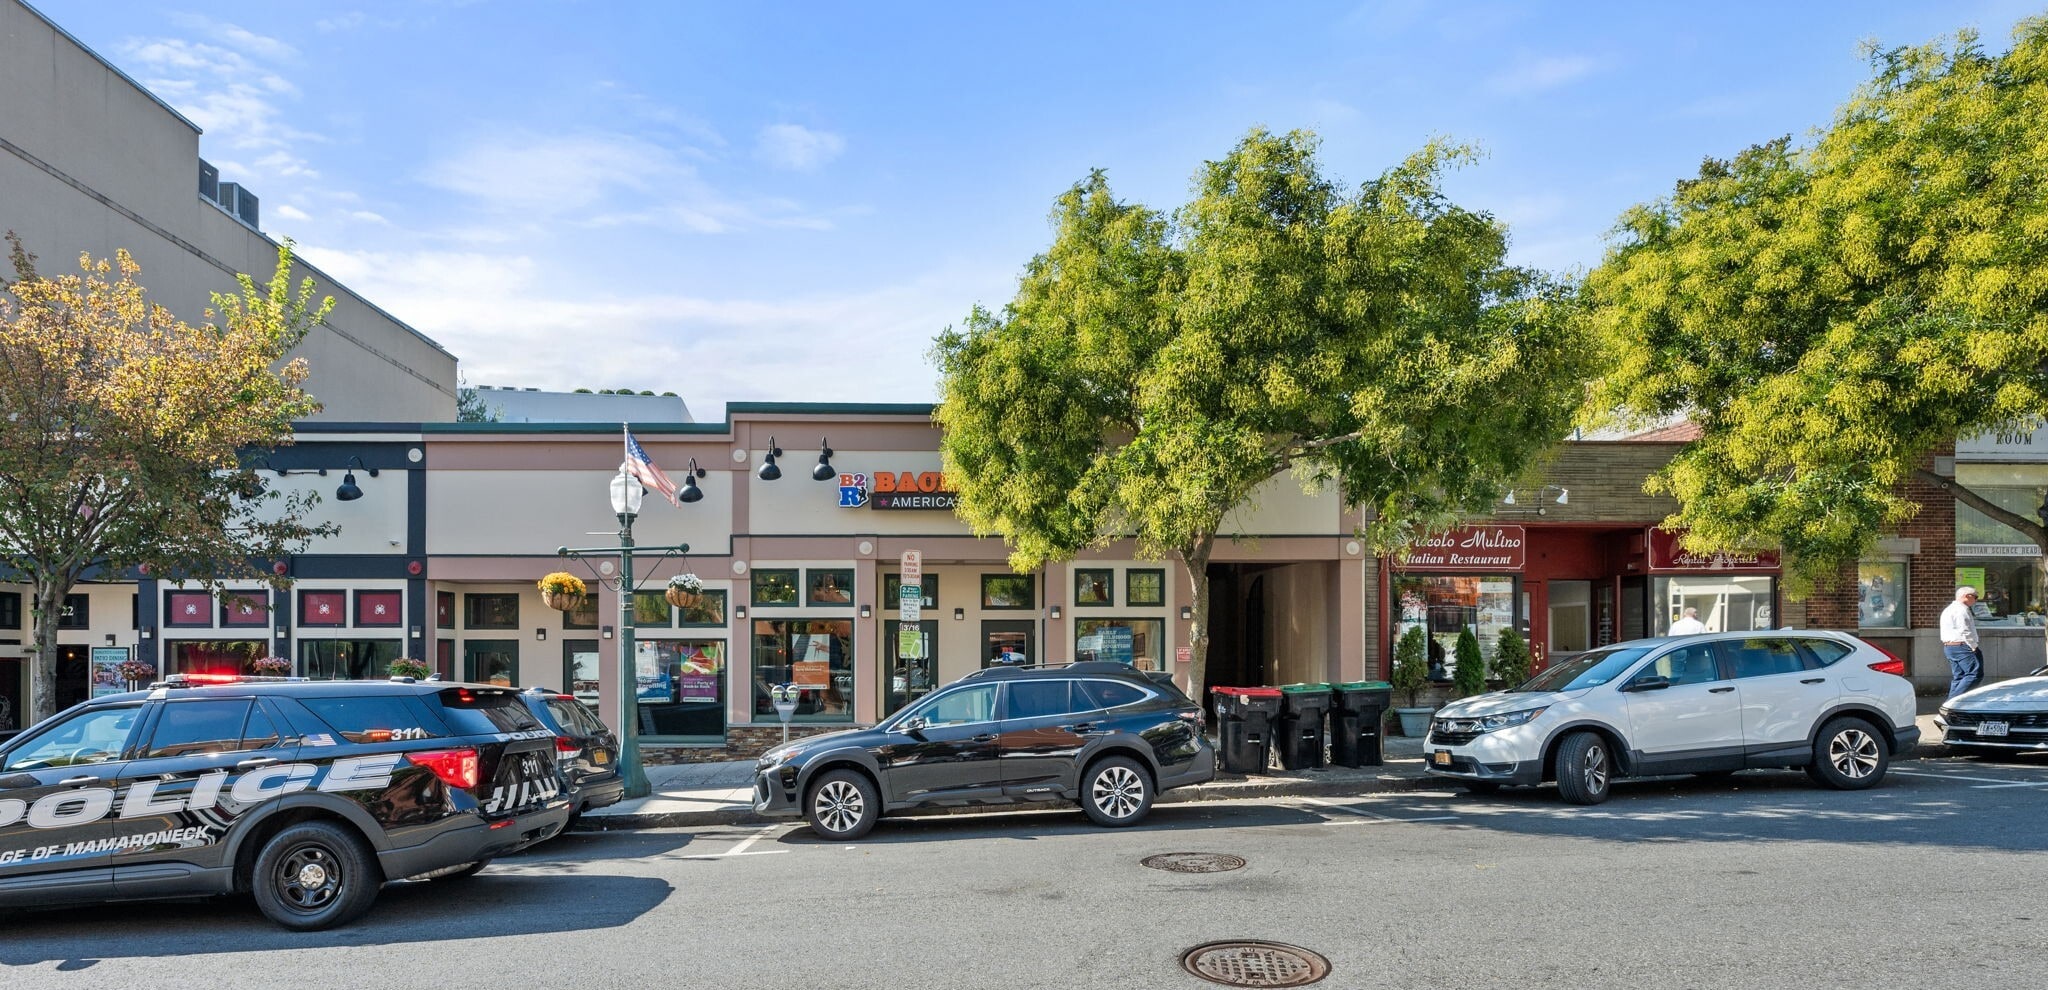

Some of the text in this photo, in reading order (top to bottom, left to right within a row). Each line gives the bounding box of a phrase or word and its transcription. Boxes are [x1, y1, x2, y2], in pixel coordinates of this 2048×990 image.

[1460, 529, 1521, 550] Mulino
[1407, 553, 1512, 565] Italian Restaurant
[1991, 547, 2019, 555] SCIENCE
[391, 727, 421, 741] 311
[522, 758, 539, 776] 311
[31, 844, 60, 861] OF
[64, 825, 210, 857] MAMARONECK
